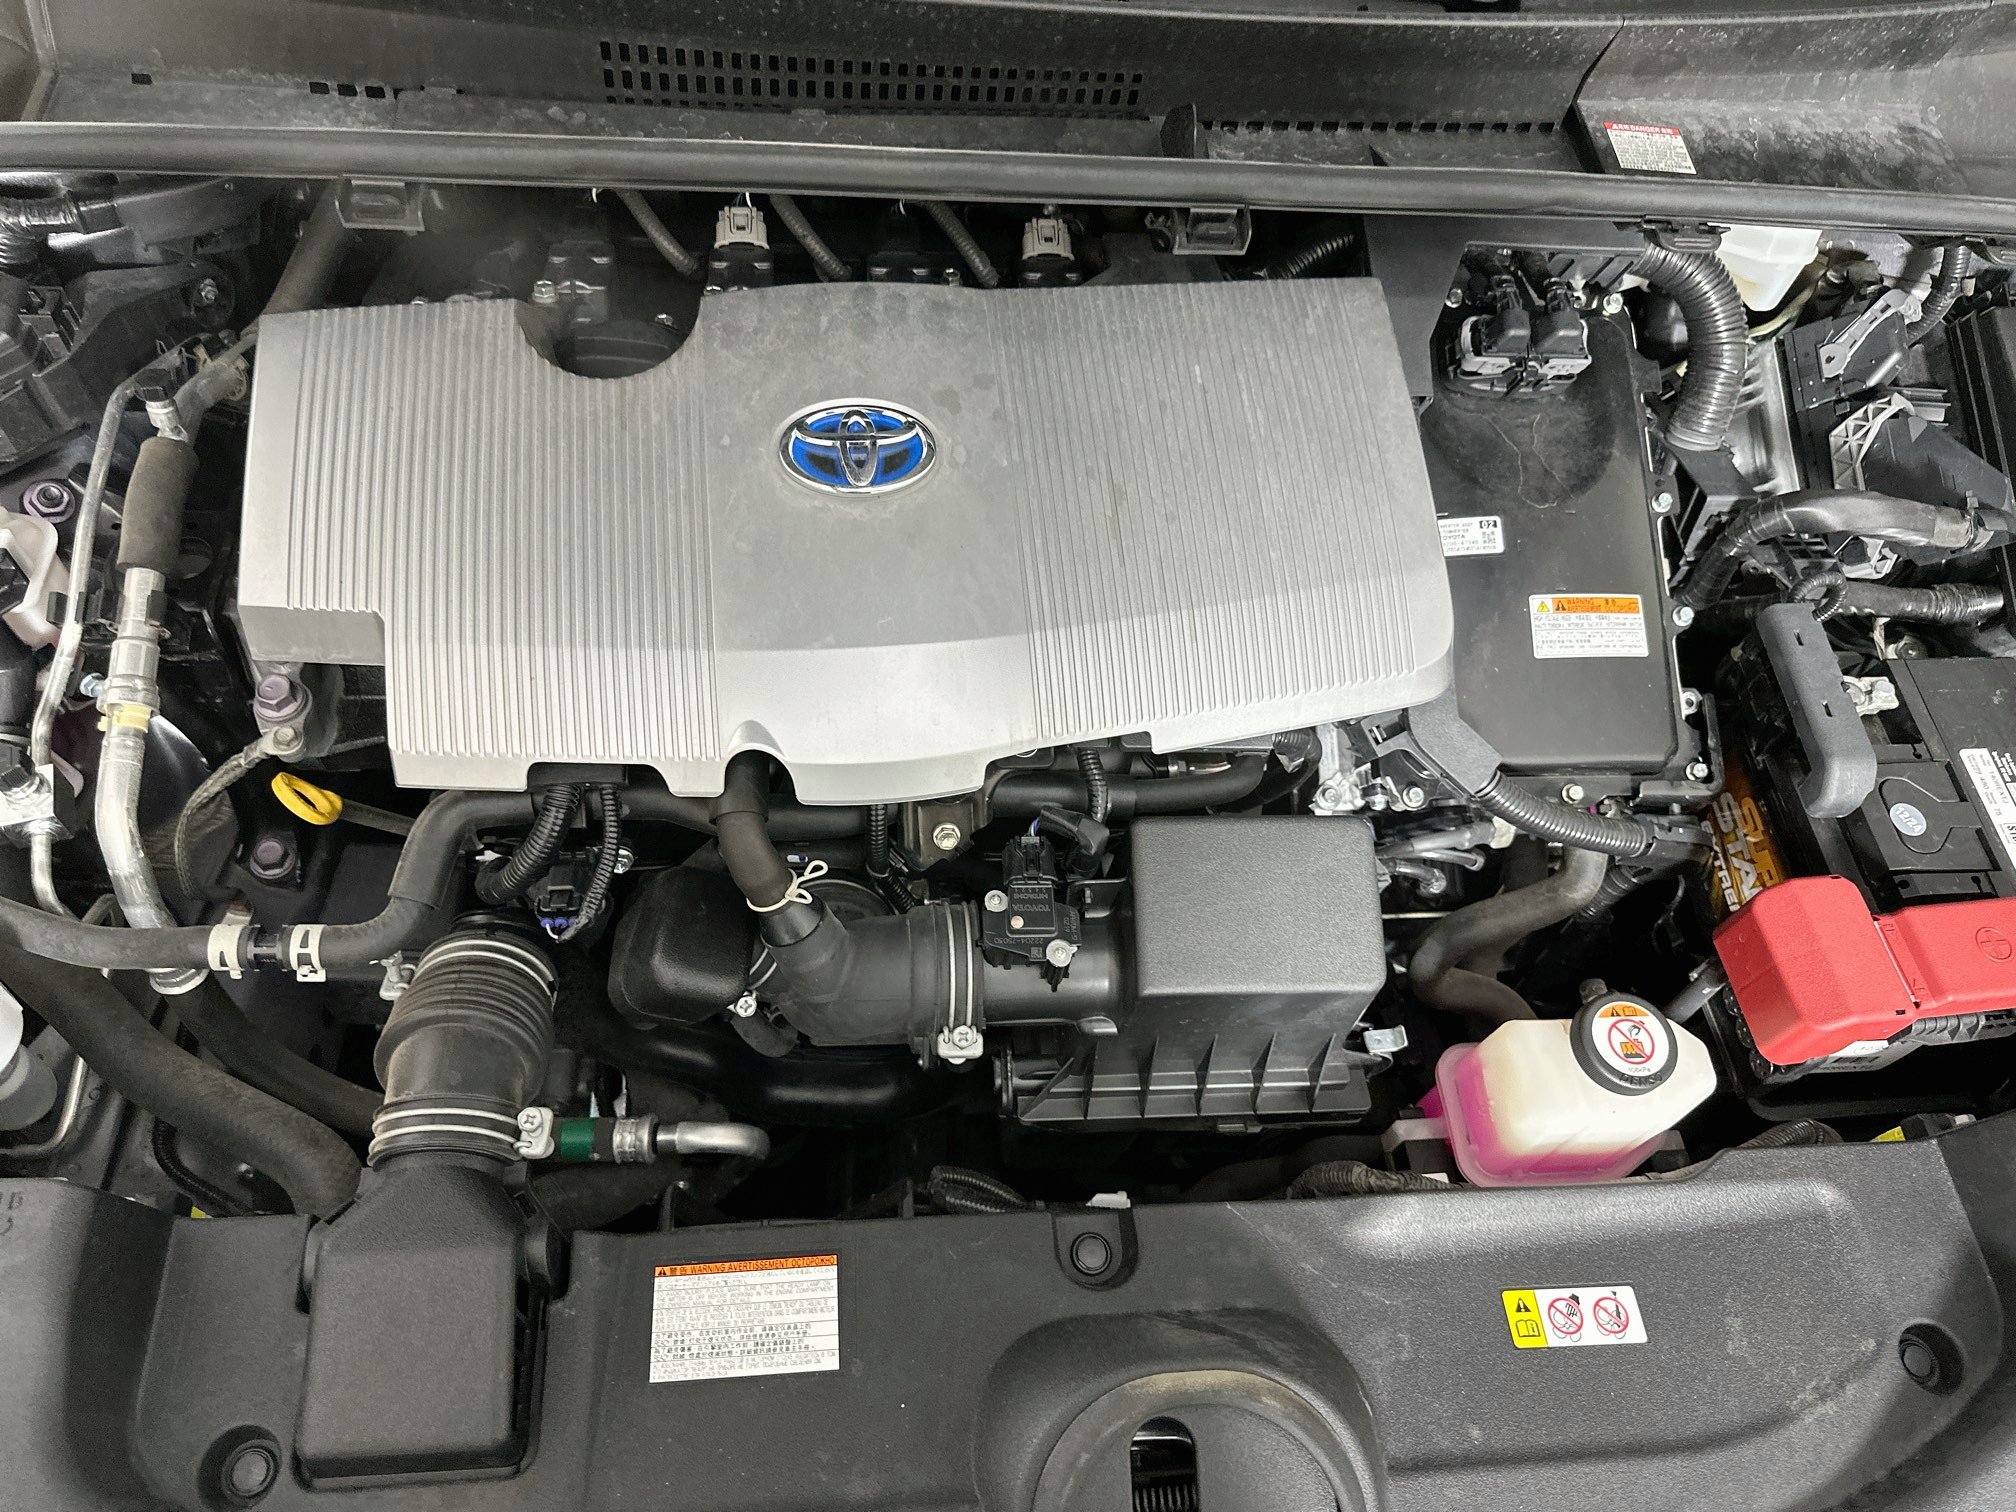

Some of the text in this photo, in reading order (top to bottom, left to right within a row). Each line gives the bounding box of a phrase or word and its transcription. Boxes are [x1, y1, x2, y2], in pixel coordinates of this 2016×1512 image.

[1630, 124, 1660, 133] DANGER
[1481, 520, 1496, 529] 02
[1894, 806, 1923, 832] 12/24
[1700, 820, 1740, 912] EXTRE
[1619, 1072, 1663, 1087] DENSO
[691, 1264, 726, 1274] WARNING
[728, 1258, 789, 1272] AVERTISSEMENT
